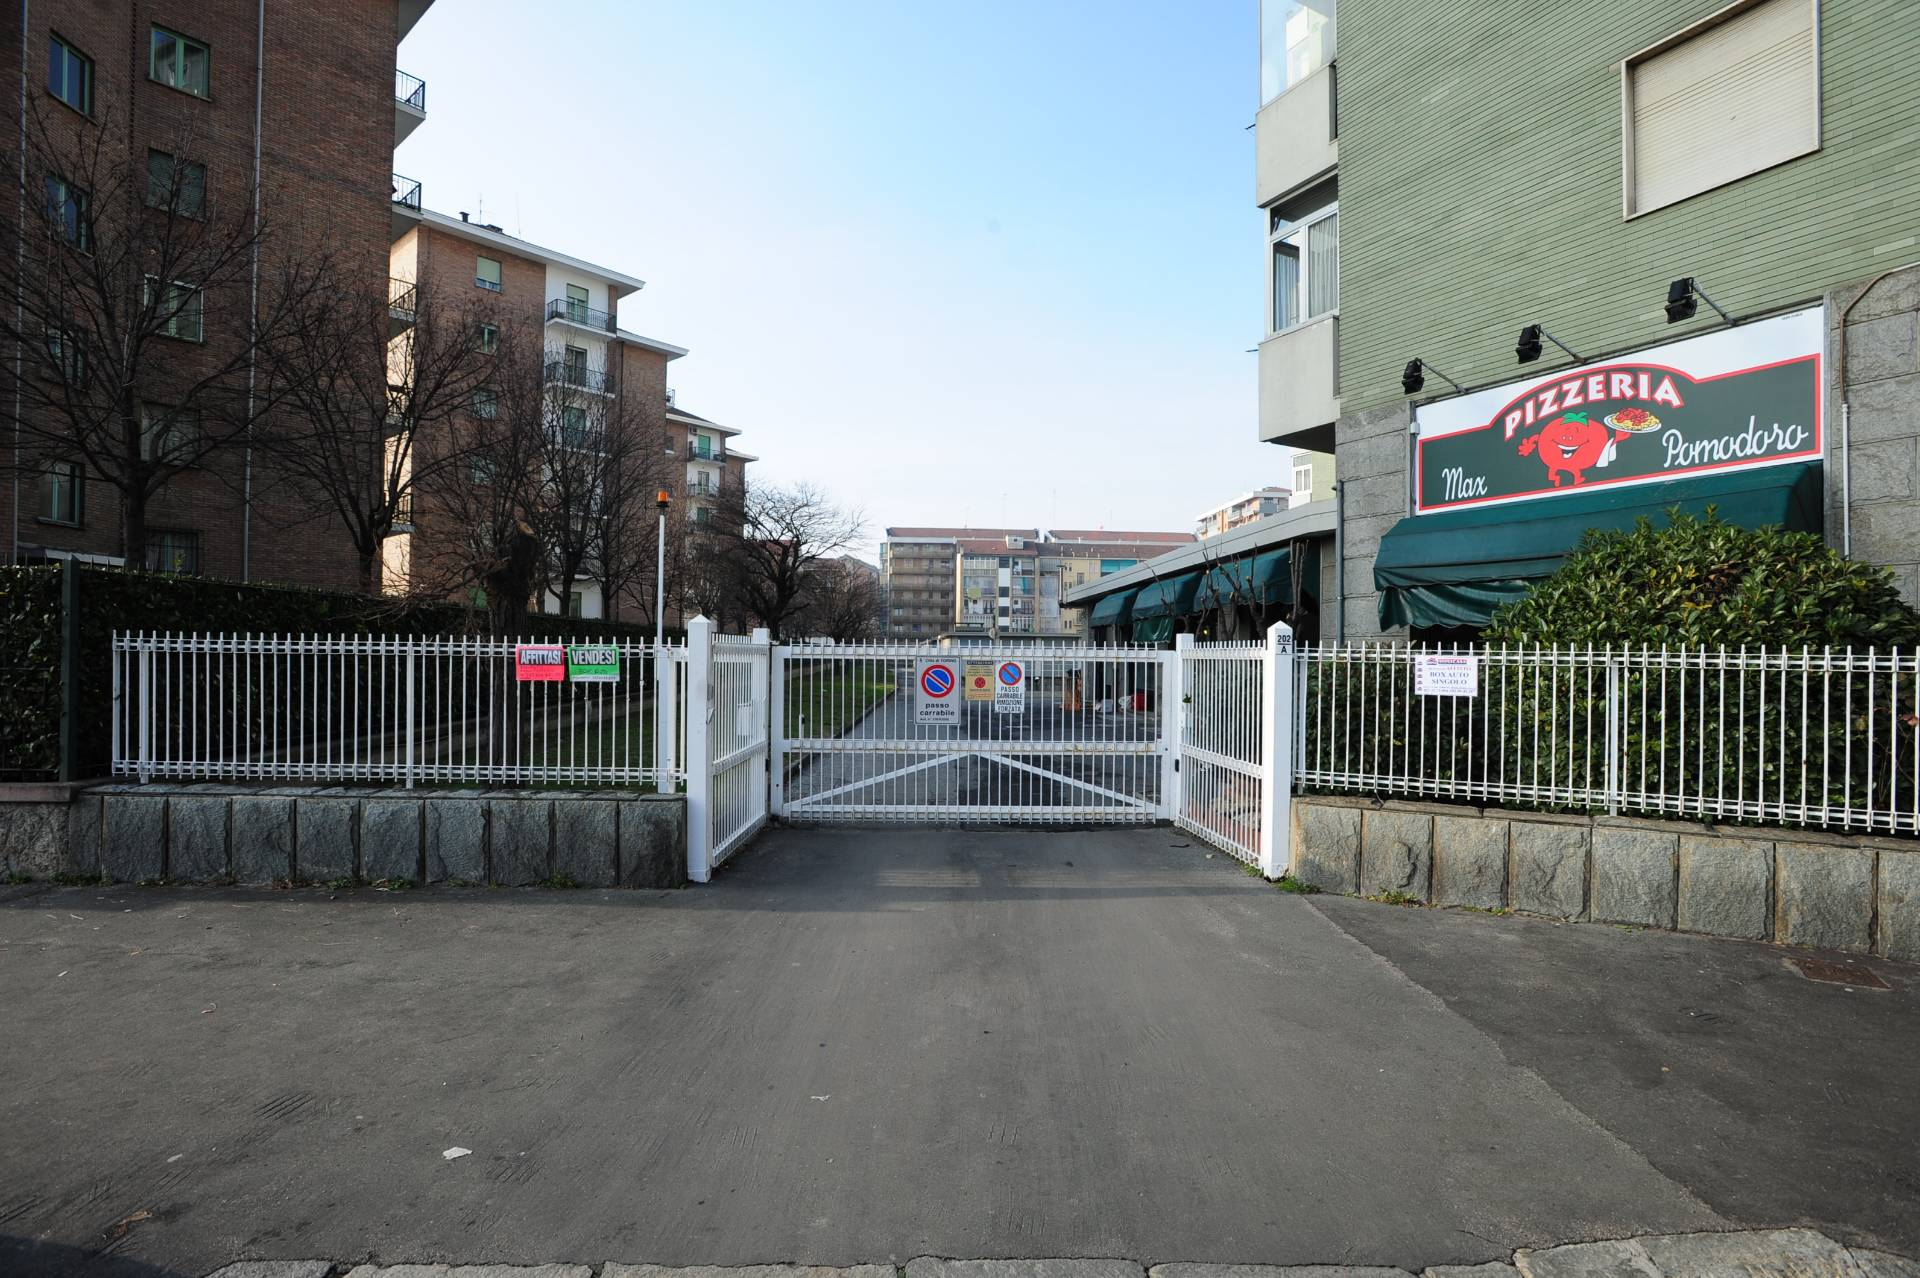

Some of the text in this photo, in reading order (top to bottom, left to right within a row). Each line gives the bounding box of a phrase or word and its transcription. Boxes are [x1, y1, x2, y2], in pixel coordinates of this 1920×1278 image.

[1504, 371, 1684, 442] PIZZERIA
[1442, 416, 1809, 501] Max Pomodoro
[1277, 635, 1291, 643] 202
[520, 650, 561, 665] AFFITTASI
[571, 650, 616, 665] VENDESI
[1280, 646, 1288, 654] A
